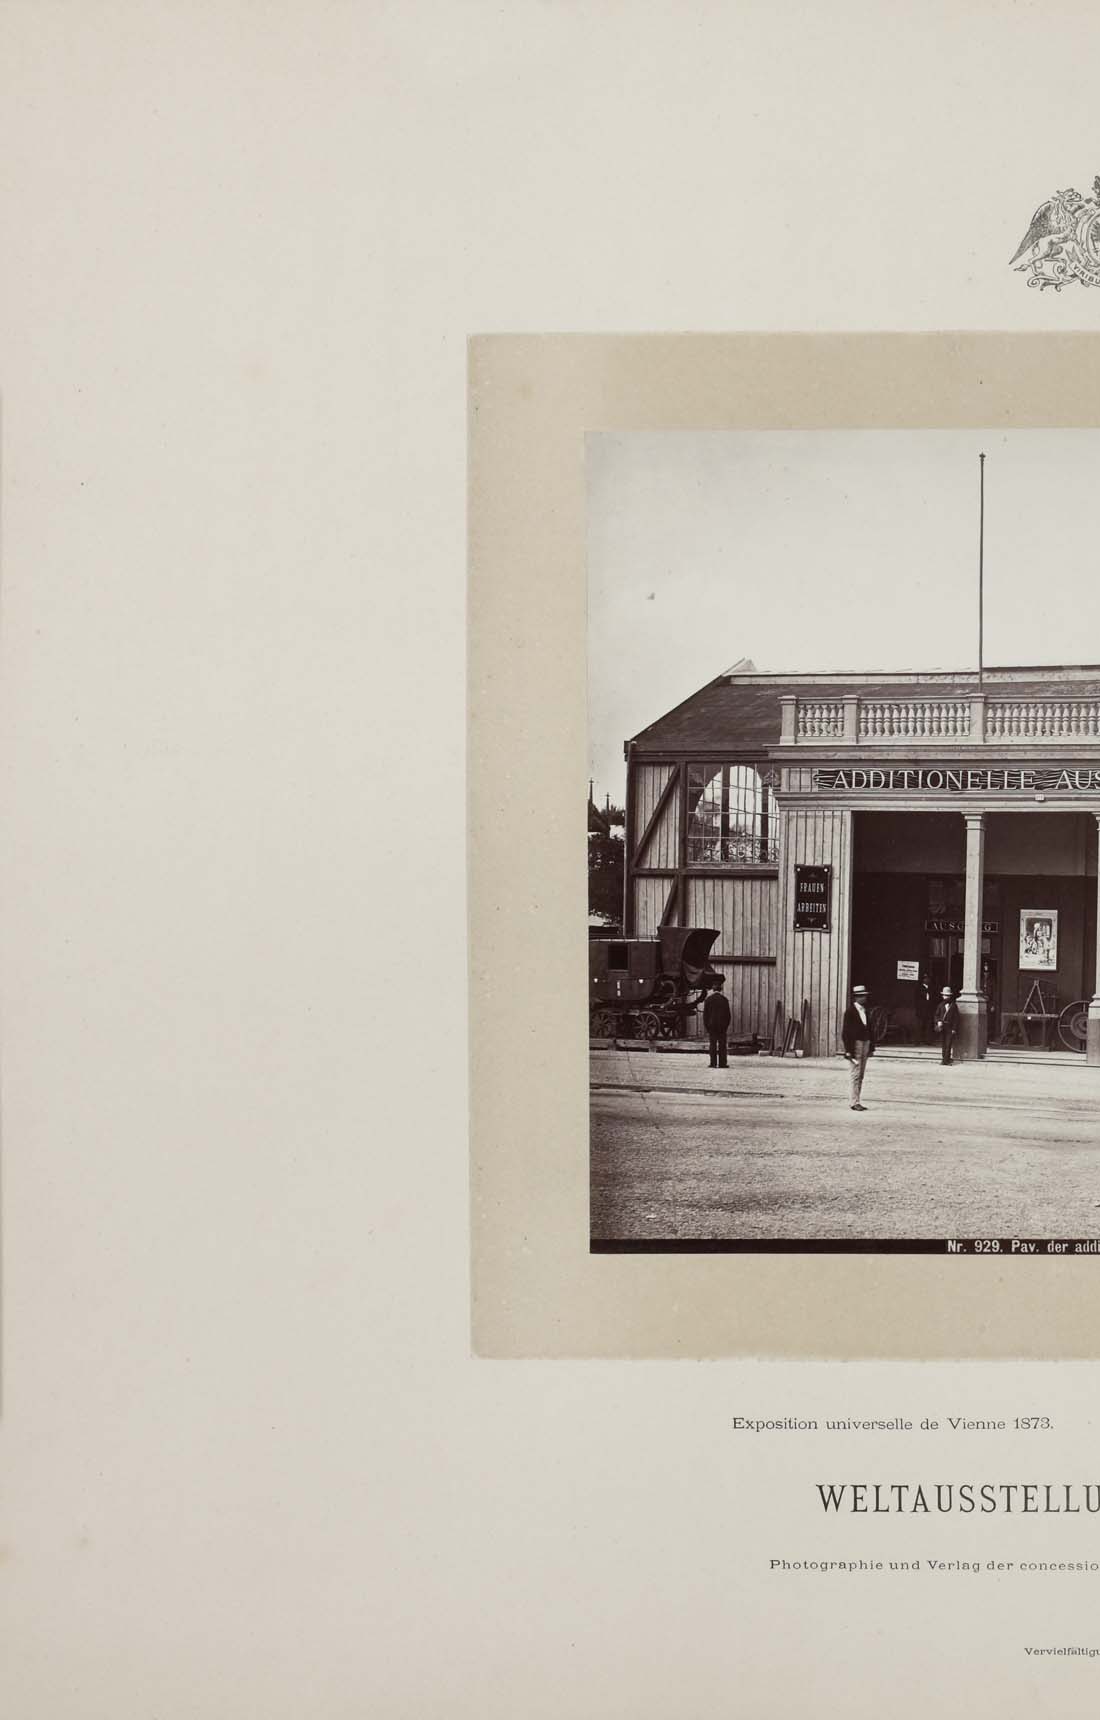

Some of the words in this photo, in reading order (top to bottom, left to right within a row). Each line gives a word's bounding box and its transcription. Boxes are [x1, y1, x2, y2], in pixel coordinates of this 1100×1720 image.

[834, 771, 1037, 790] ADDITIONELLE
[799, 882, 824, 893] FRAUEN
[732, 1416, 819, 1433] Exposition
[825, 1417, 913, 1431] universelle
[919, 1417, 939, 1431] de
[946, 1417, 1006, 1431] Vienne
[1013, 1416, 1054, 1430] 1873.
[768, 1559, 884, 1573] Photographie
[888, 1559, 921, 1571] und
[926, 1559, 981, 1574] Verlag
[986, 1559, 1015, 1571] der
